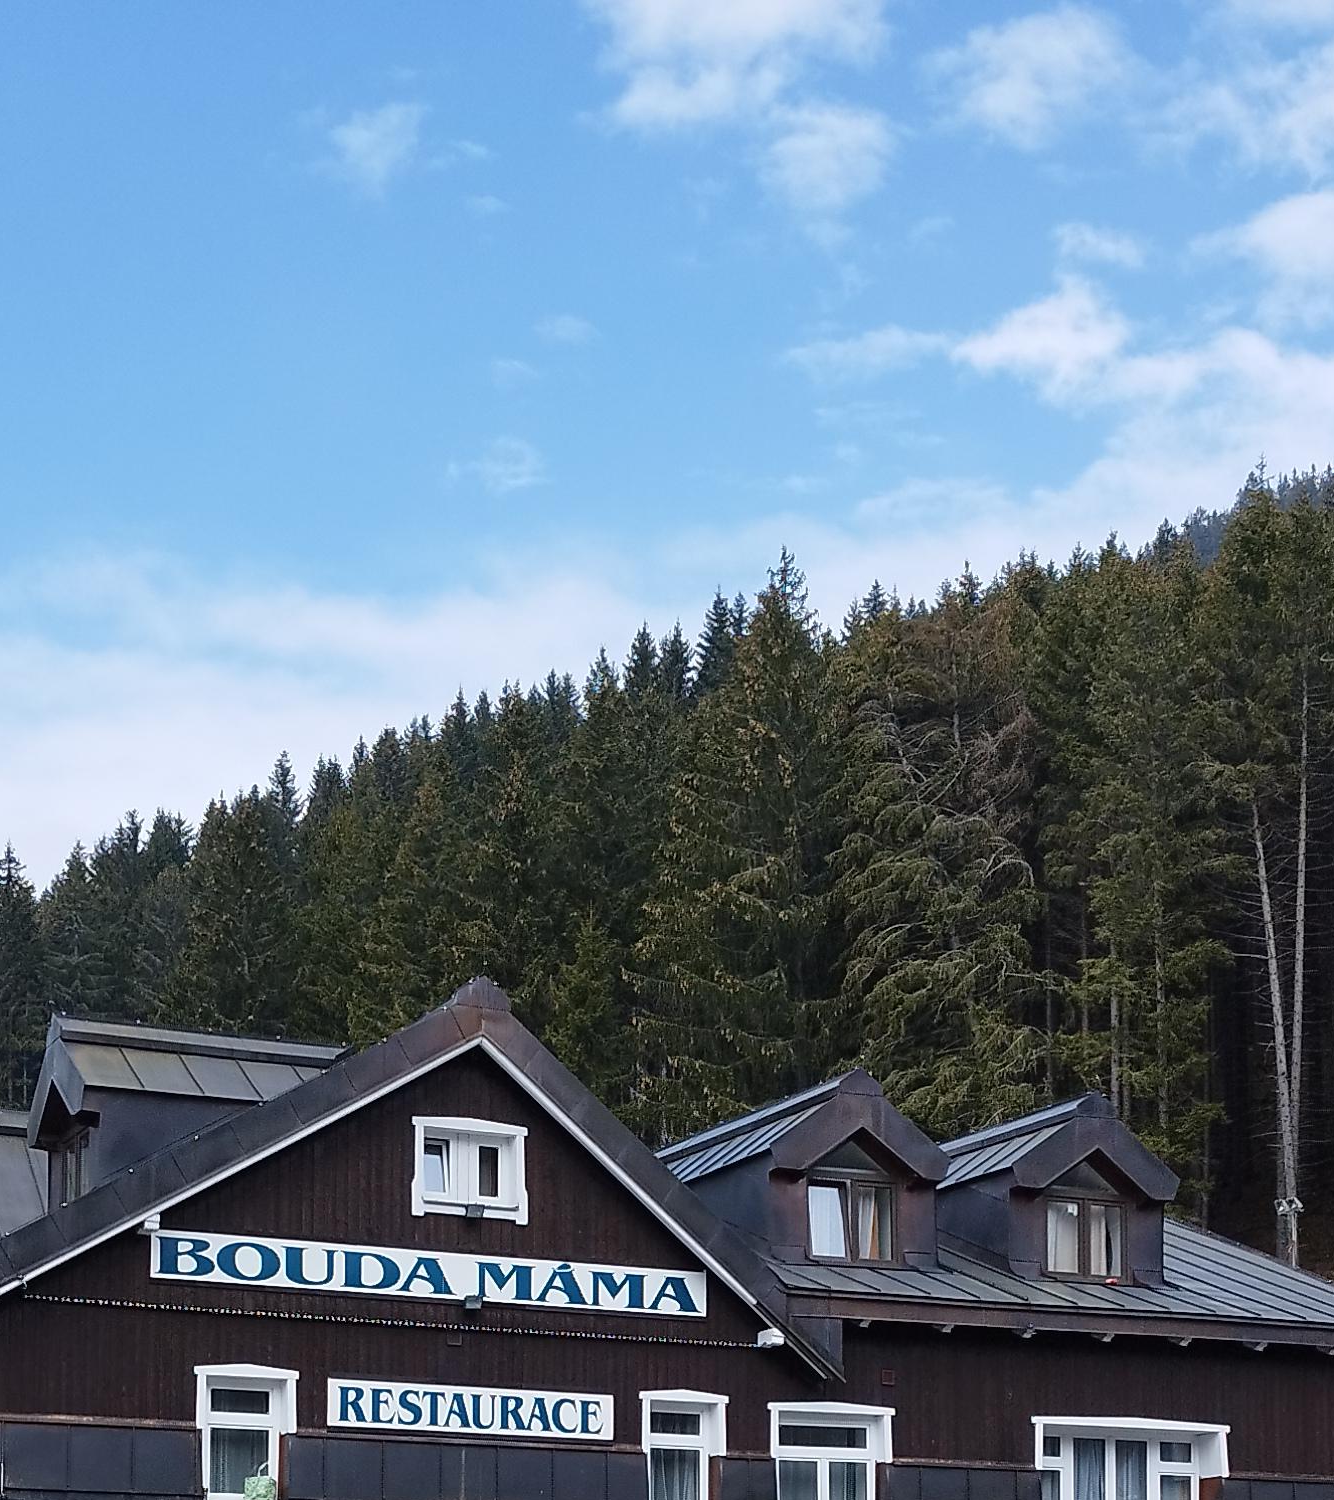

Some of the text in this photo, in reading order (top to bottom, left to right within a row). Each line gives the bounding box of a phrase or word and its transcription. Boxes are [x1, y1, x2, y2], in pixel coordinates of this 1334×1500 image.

[155, 1235, 702, 1313] BOUDA MÁMA
[338, 1385, 605, 1435] RESTAURACE
